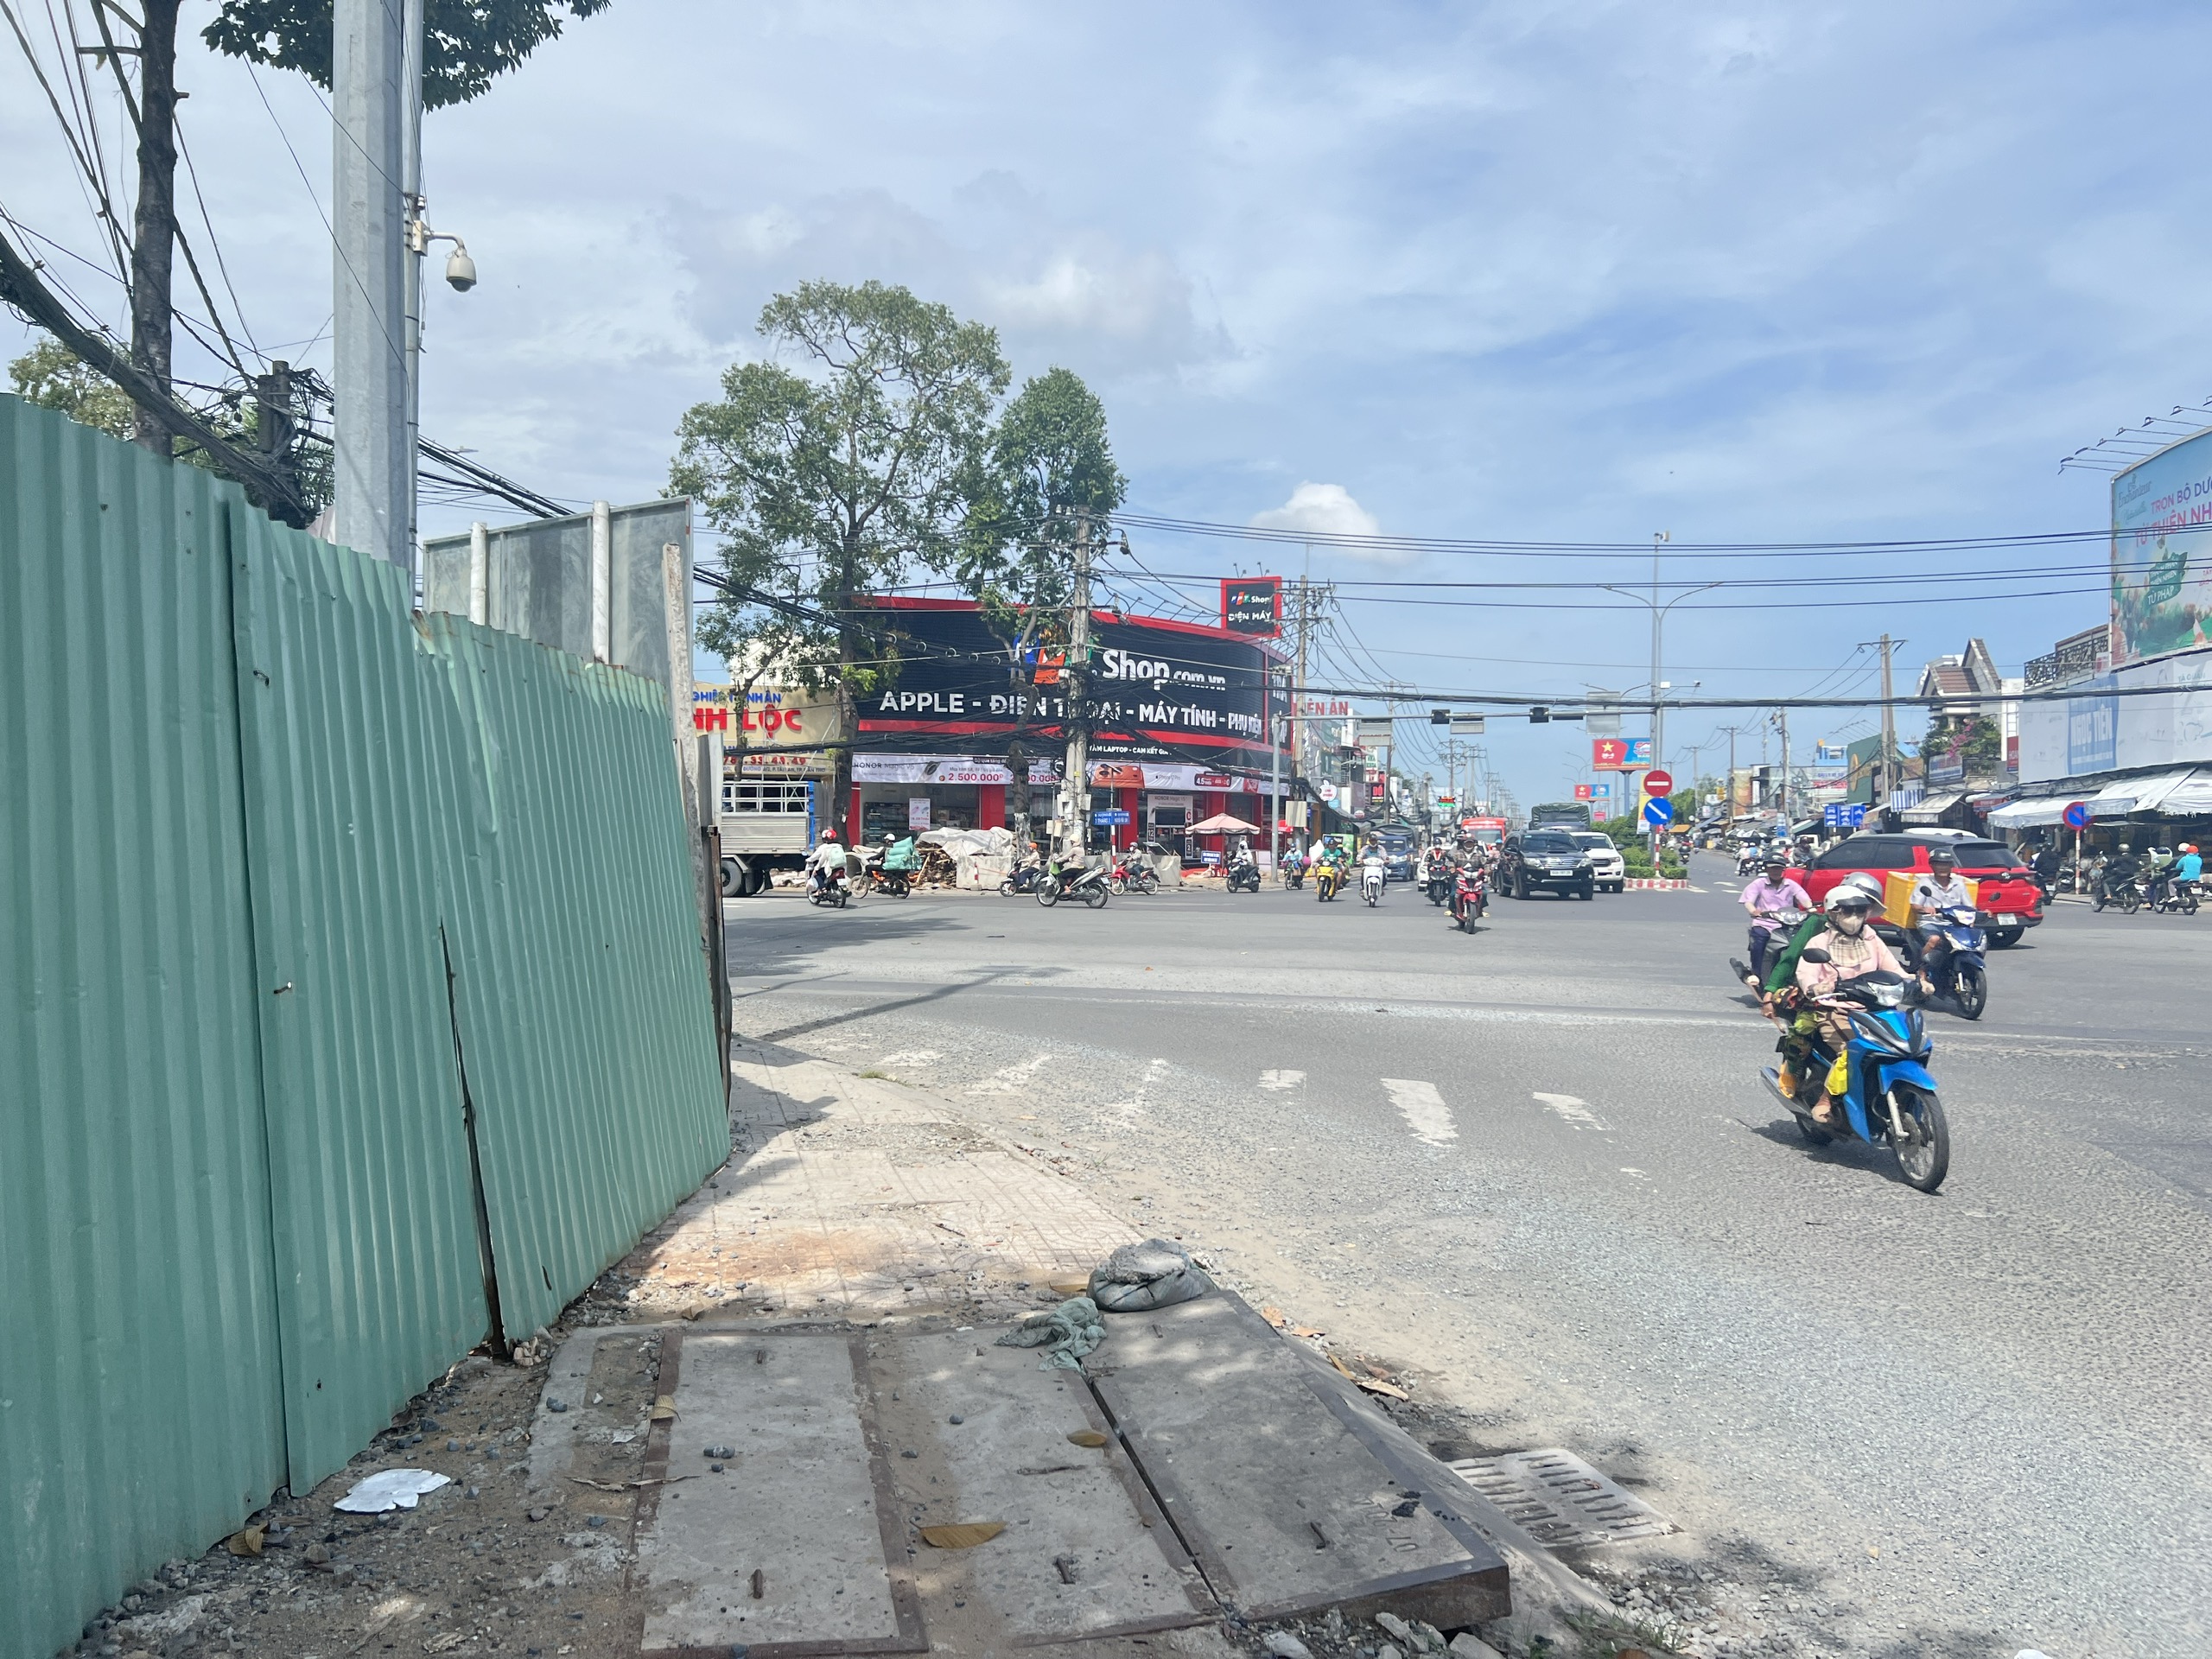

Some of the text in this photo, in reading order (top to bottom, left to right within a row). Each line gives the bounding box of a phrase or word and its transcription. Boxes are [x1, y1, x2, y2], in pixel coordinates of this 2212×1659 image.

[2177, 482, 2191, 505] BỘ
[1251, 609, 1272, 621] MÁY
[742, 703, 802, 739] LỘC
[880, 691, 964, 714] APPLE
[1139, 700, 1178, 724] MÁY
[1181, 703, 1217, 728] TÍNH
[1228, 712, 1248, 736] PHỤ
